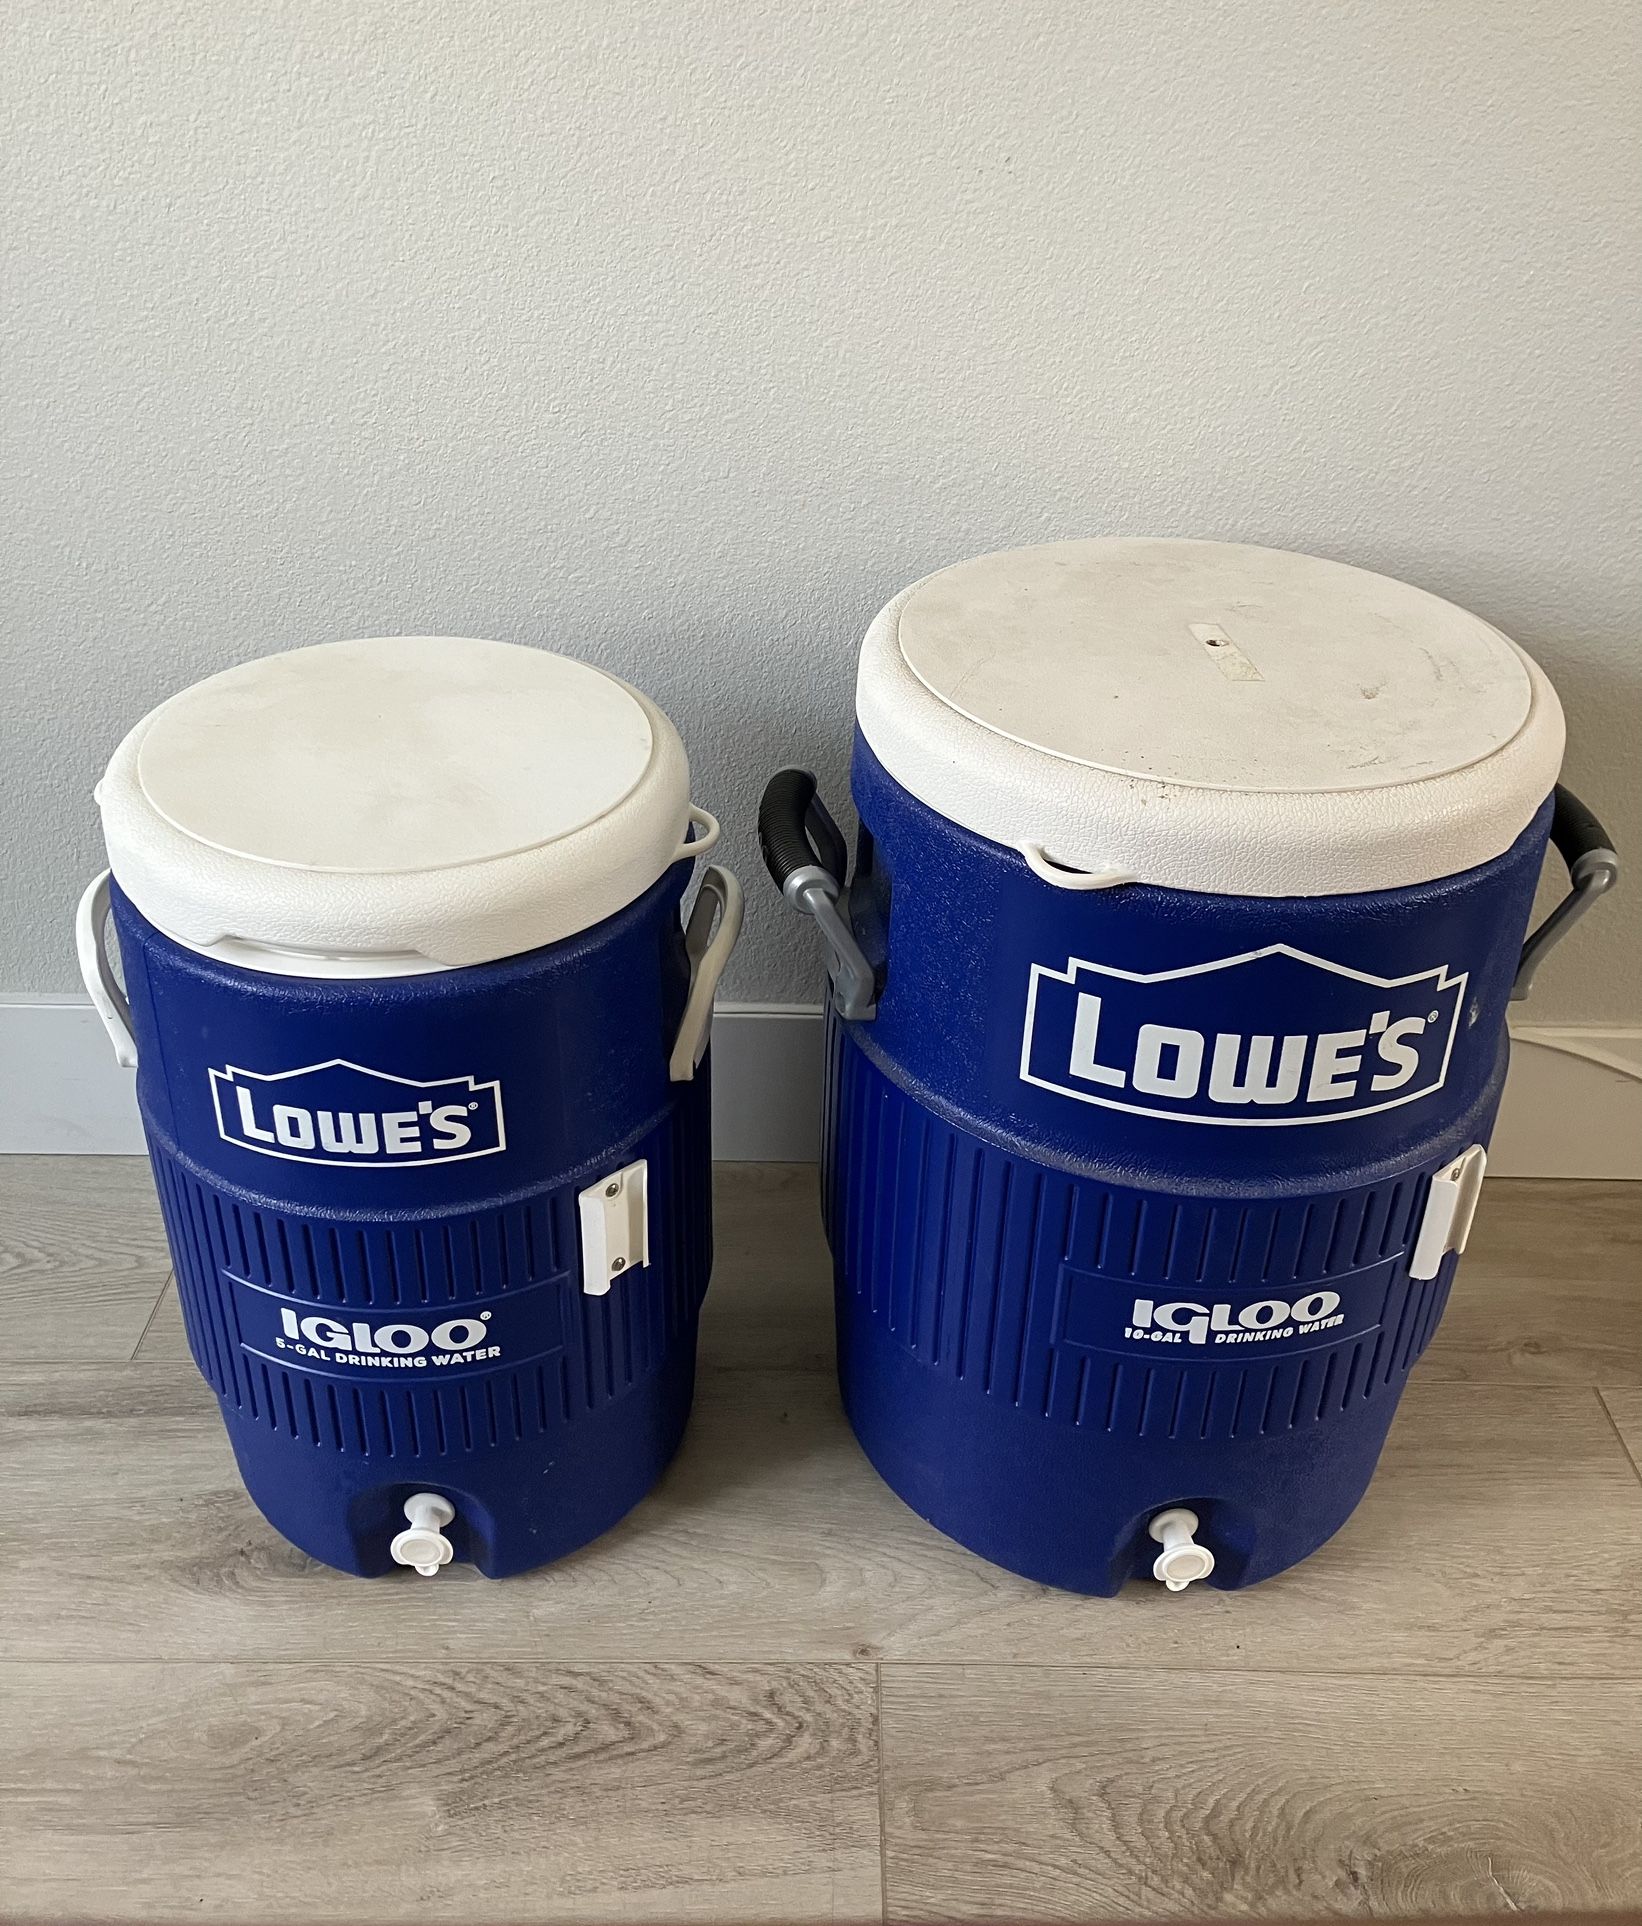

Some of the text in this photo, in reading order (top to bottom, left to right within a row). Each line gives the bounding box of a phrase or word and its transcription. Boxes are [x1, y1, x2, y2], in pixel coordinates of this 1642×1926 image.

[1069, 991, 1426, 1104] LOWE'S
[236, 1085, 472, 1154] LOWE'S
[280, 1307, 487, 1354] IGLOO
[1124, 1314, 1345, 1344] 10-GAL DRINKING WATER
[1132, 1291, 1341, 1344] IGLOO
[275, 1337, 501, 1367] 5-GAL DRINKING WATER
